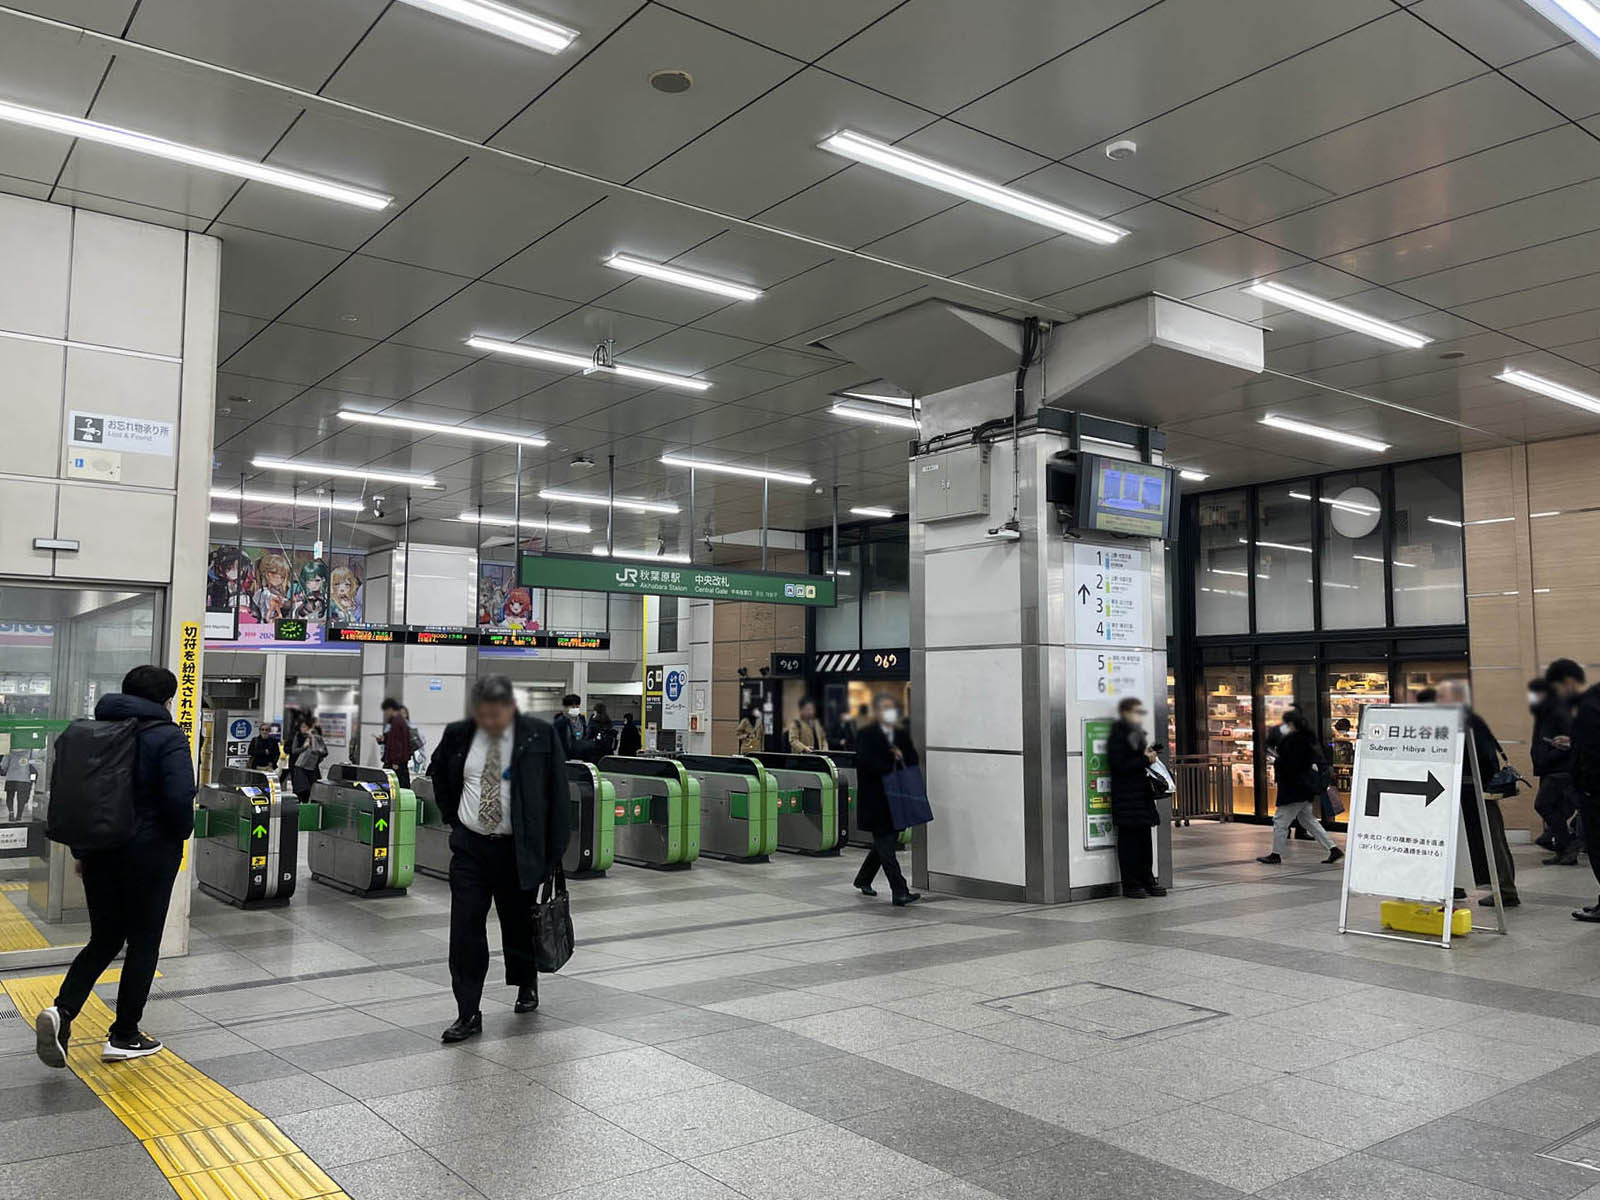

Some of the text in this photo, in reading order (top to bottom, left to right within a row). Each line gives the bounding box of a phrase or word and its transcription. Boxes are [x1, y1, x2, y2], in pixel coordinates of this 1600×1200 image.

[107, 420, 169, 439] お忘れ物承り所
[1096, 551, 1102, 566] 1
[615, 568, 638, 583] JR
[640, 569, 730, 587] 秋葉原駅 中央改札
[1096, 573, 1103, 589] 2
[640, 583, 668, 591] Akihabara
[694, 586, 714, 594] Central
[715, 587, 729, 595] Gate
[1096, 597, 1104, 613] 3
[1096, 621, 1104, 637] 4
[1097, 654, 1105, 670] 5
[647, 670, 654, 690] 6
[1097, 677, 1105, 693] 6
[1388, 725, 1449, 740] 日比谷線
[240, 743, 247, 753] 5
[1402, 744, 1426, 754] Hibiya
[1431, 745, 1448, 754] Line
